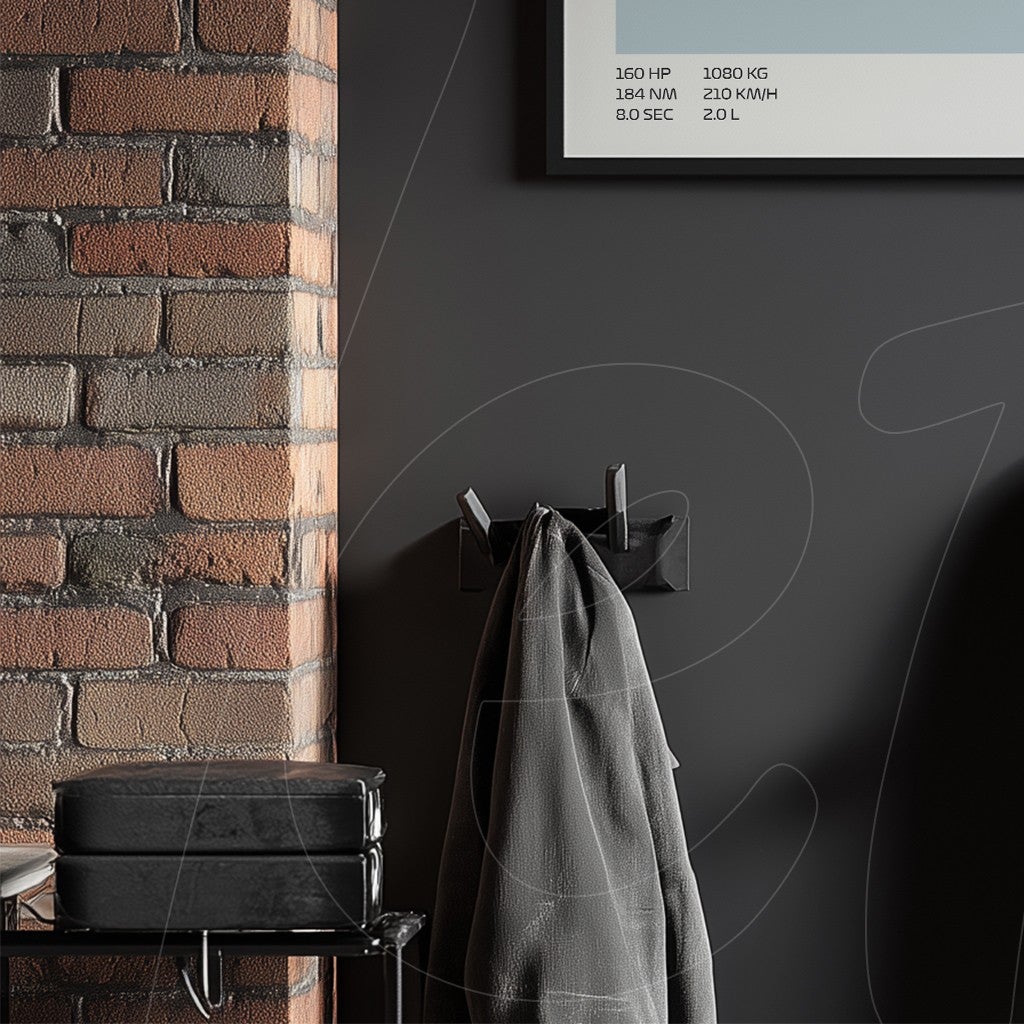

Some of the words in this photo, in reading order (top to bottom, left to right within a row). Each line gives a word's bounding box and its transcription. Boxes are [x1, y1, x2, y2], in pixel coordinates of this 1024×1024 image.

[615, 67, 645, 80] 160
[649, 67, 672, 80] HP
[703, 67, 743, 80] 1080
[747, 67, 768, 80] KG
[615, 87, 646, 101] 184
[649, 87, 678, 101] NM
[703, 87, 732, 101] 210
[736, 87, 778, 102] KM/H
[615, 108, 640, 121] 8.0
[643, 108, 674, 121] SEC
[703, 108, 727, 121] 2.0
[731, 108, 740, 121] L
